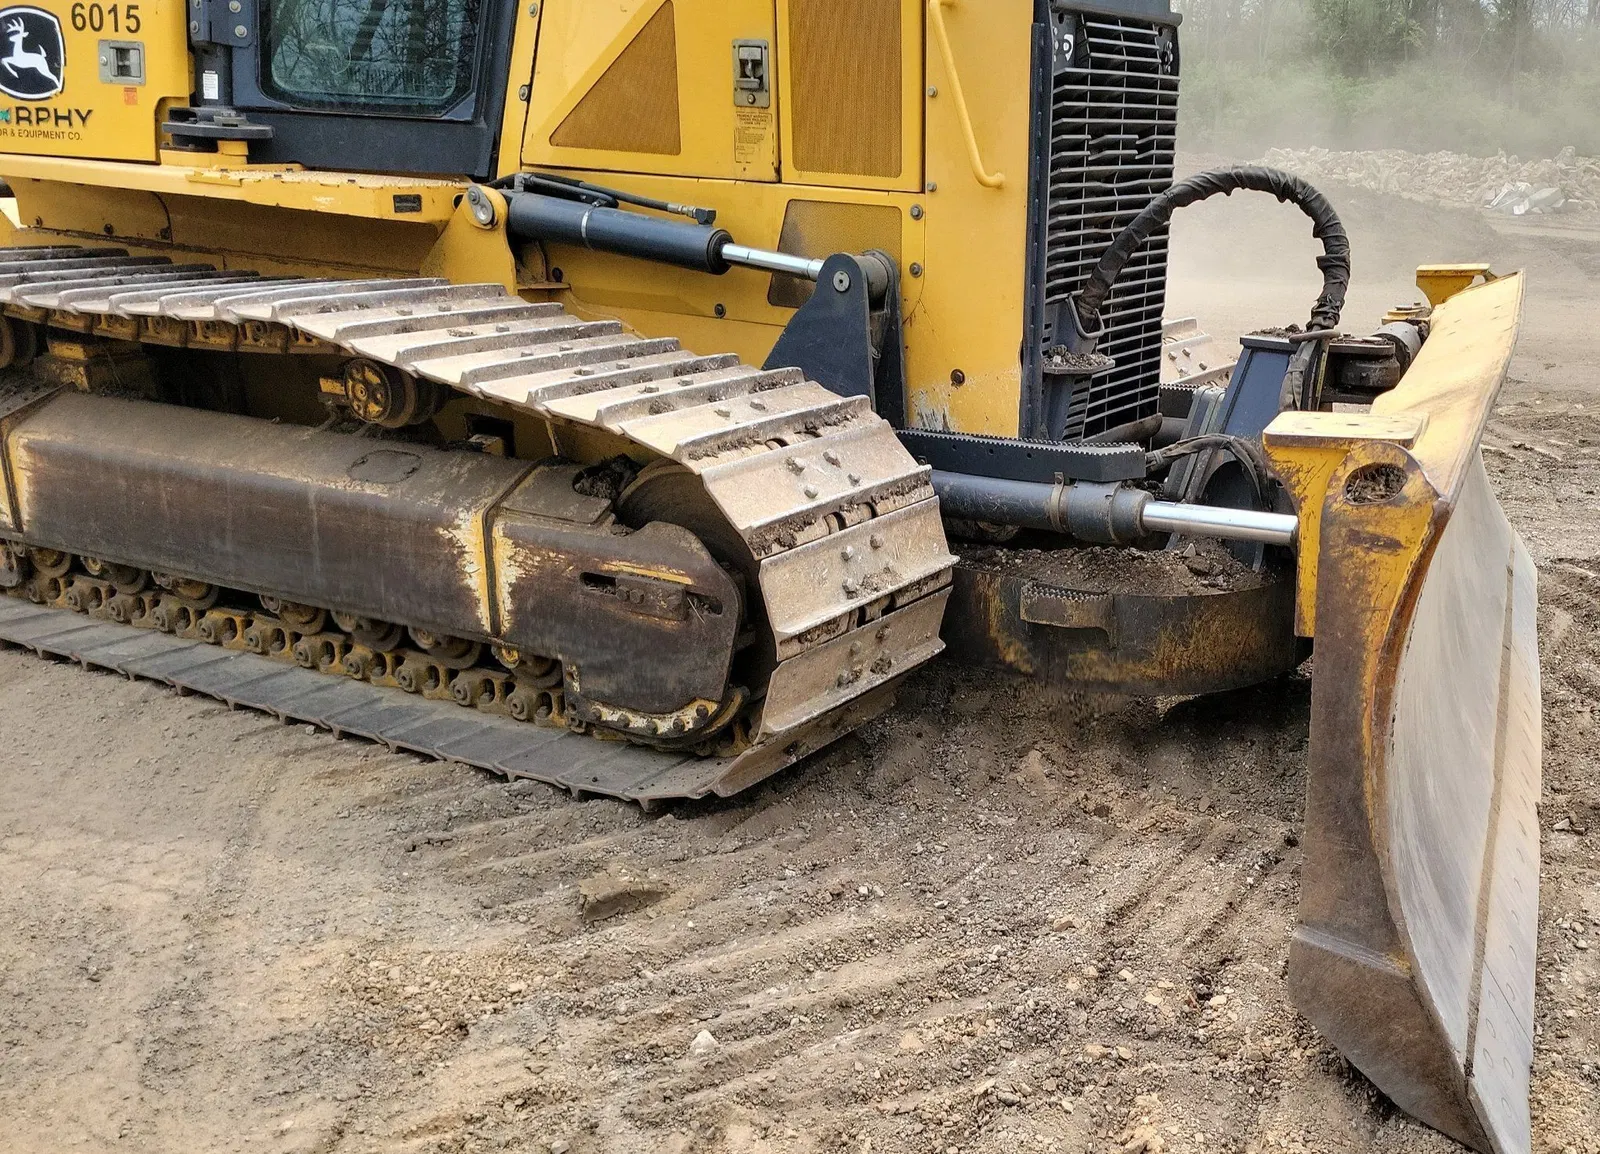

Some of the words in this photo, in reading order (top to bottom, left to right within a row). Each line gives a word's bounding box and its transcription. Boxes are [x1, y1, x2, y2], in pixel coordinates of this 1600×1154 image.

[71, 3, 141, 34] 6015
[10, 128, 15, 137] &
[18, 129, 65, 140] EQUIPMENT
[68, 132, 83, 141] CO.
